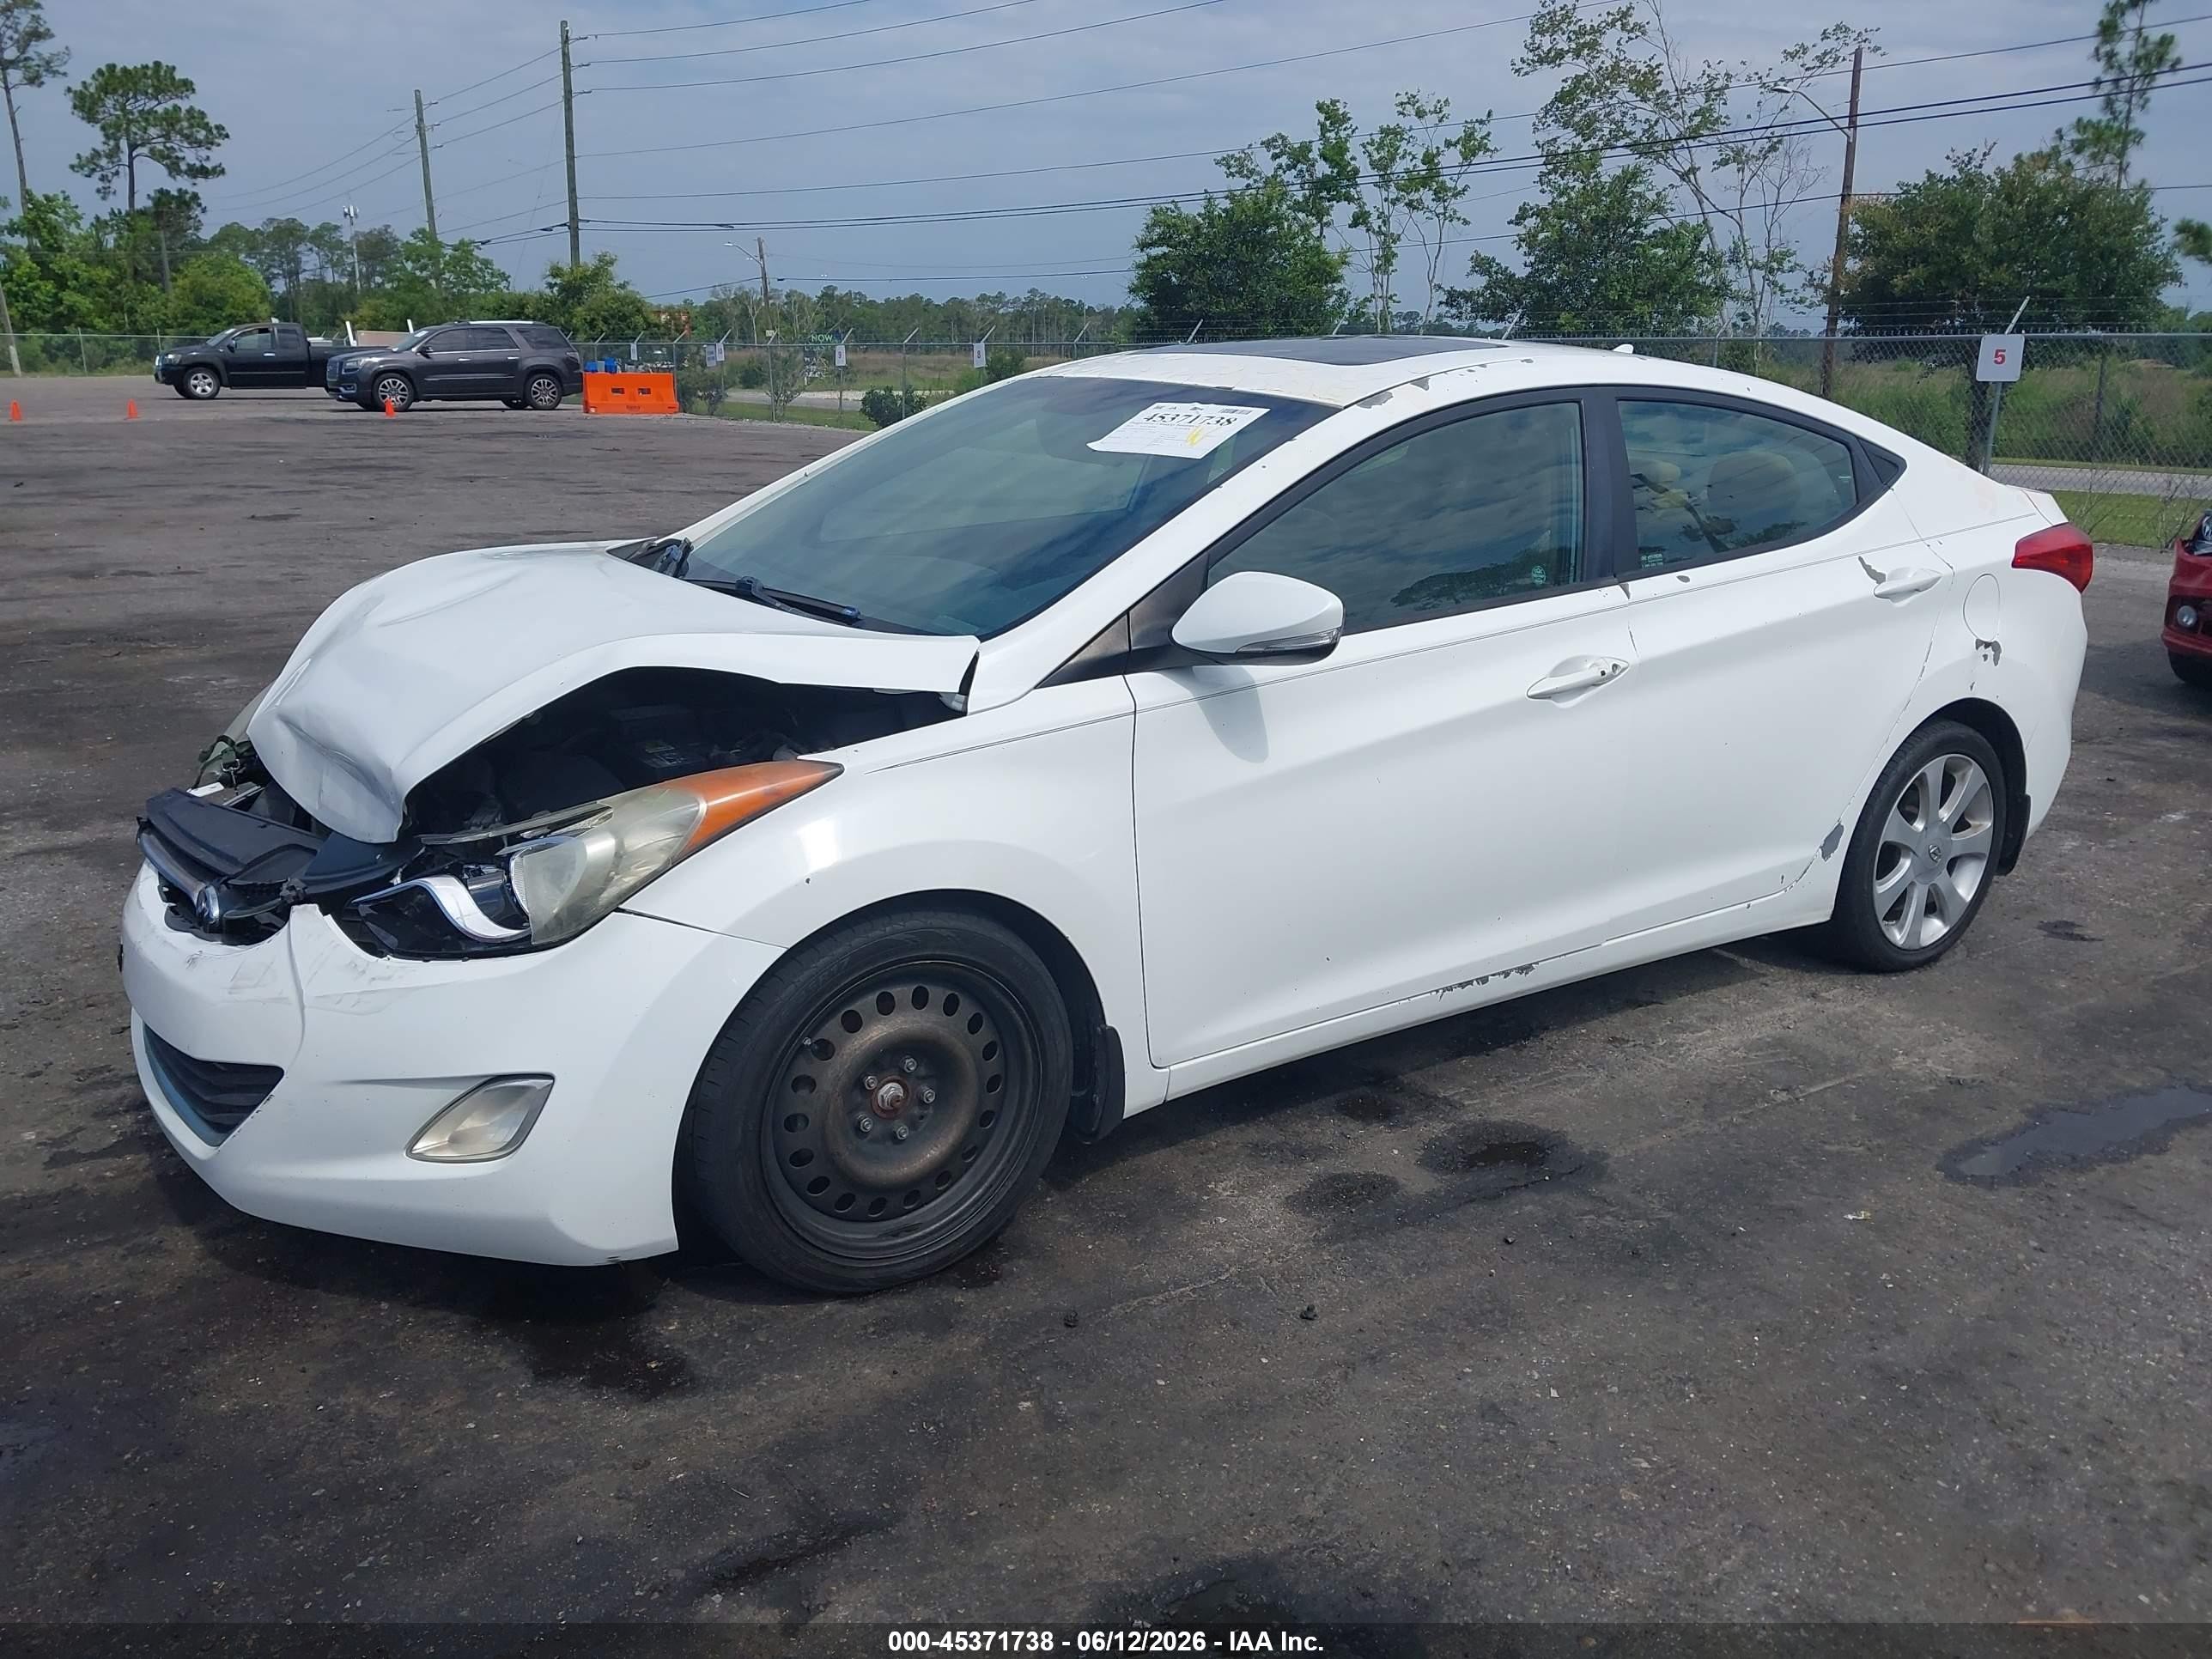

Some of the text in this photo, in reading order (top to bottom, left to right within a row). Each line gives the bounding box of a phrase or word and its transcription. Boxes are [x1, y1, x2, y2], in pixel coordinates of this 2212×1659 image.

[811, 334, 833, 343] NOW
[976, 349, 981, 359] 8
[1993, 349, 2006, 365] 5
[1143, 412, 1237, 426] 45371738
